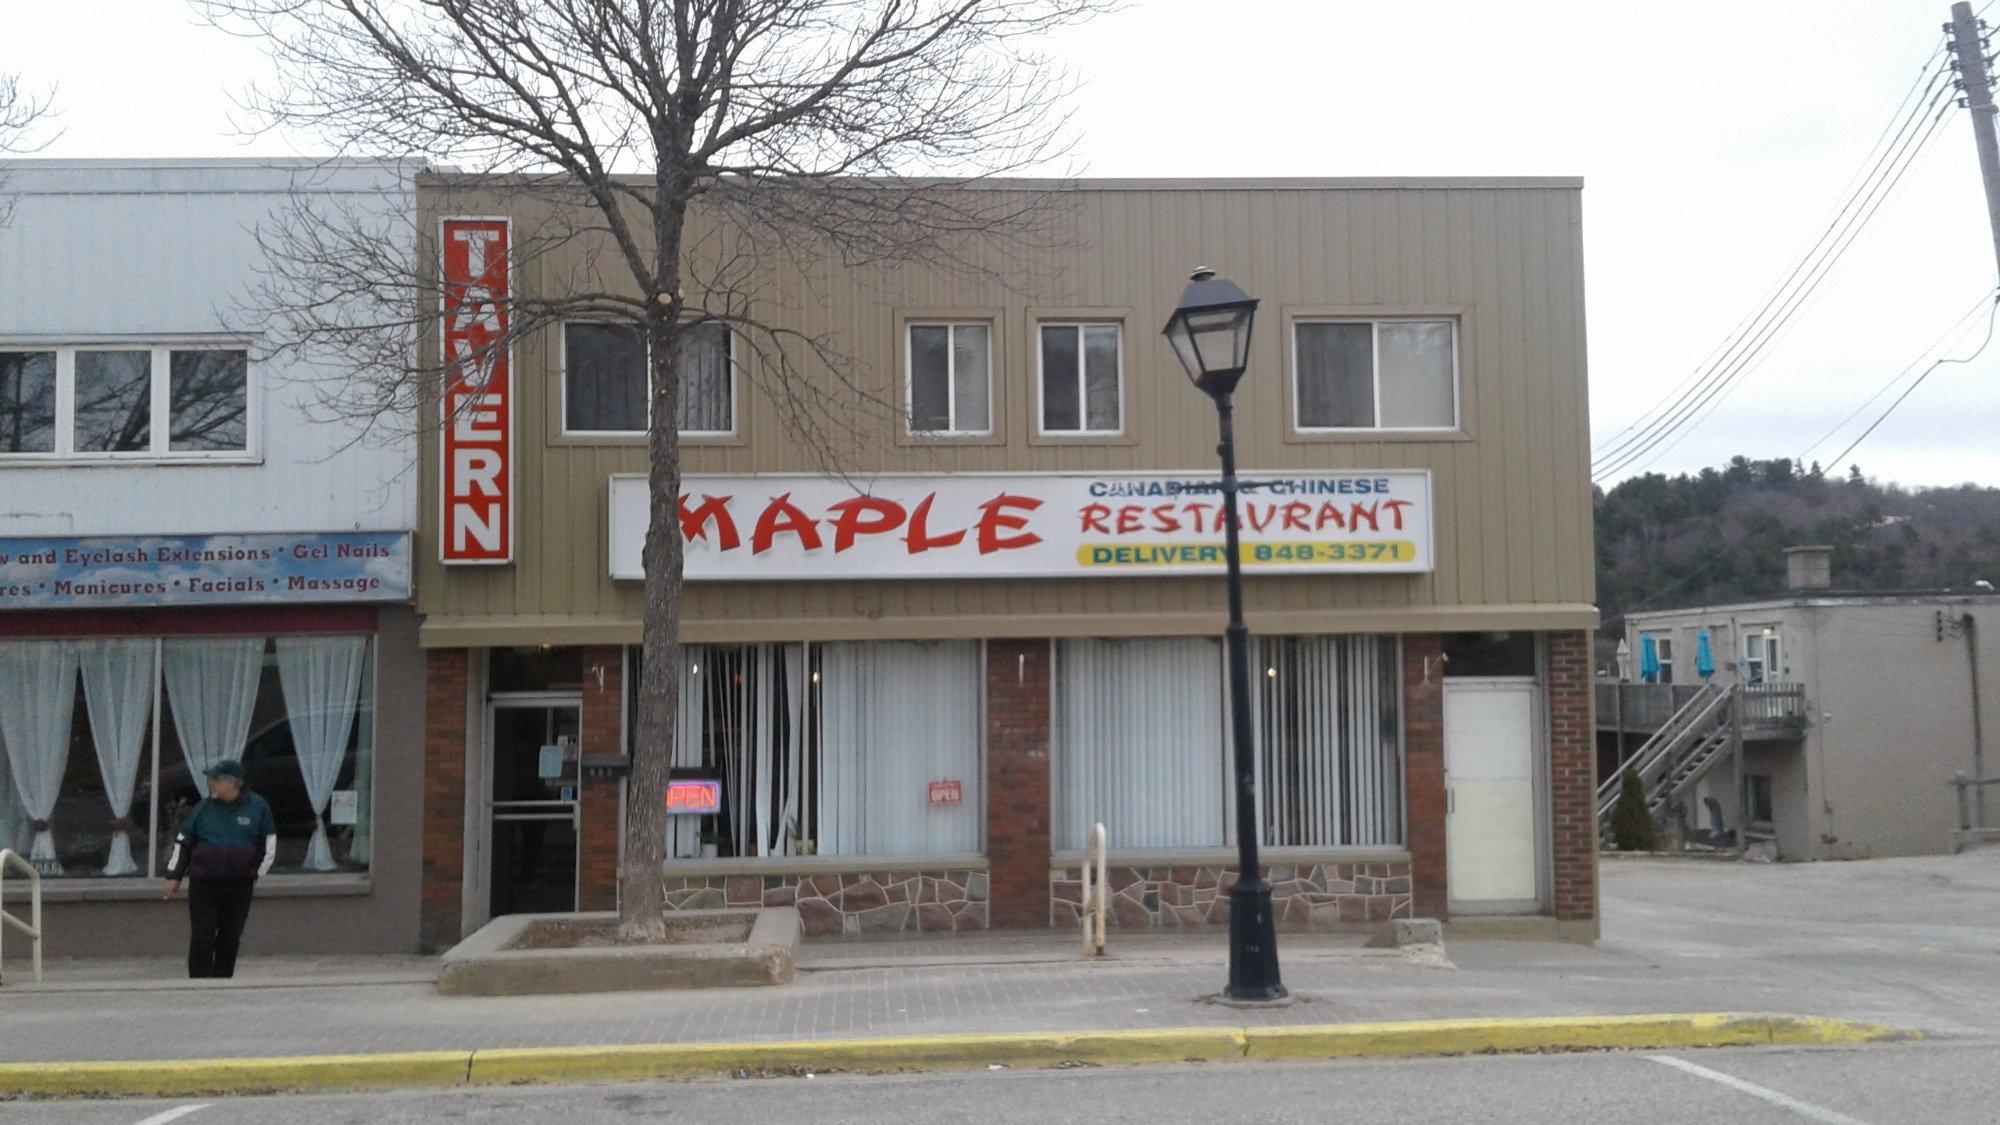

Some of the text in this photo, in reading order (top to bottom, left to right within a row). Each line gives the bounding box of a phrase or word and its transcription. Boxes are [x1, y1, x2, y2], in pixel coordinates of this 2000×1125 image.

[453, 229, 502, 552] TAVERN
[1268, 478, 1390, 494] CHINESE
[678, 490, 1045, 555] MAPLE
[18, 549, 57, 565] and
[65, 547, 148, 567] Eyelash
[157, 545, 270, 563] Extensions
[292, 543, 328, 560] Gel
[336, 543, 390, 558] Nails
[1255, 543, 1398, 561] 848-3371
[54, 579, 167, 595] Manicures
[189, 576, 265, 593] Facials
[287, 575, 381, 592] Massage
[666, 785, 715, 808] PEN
